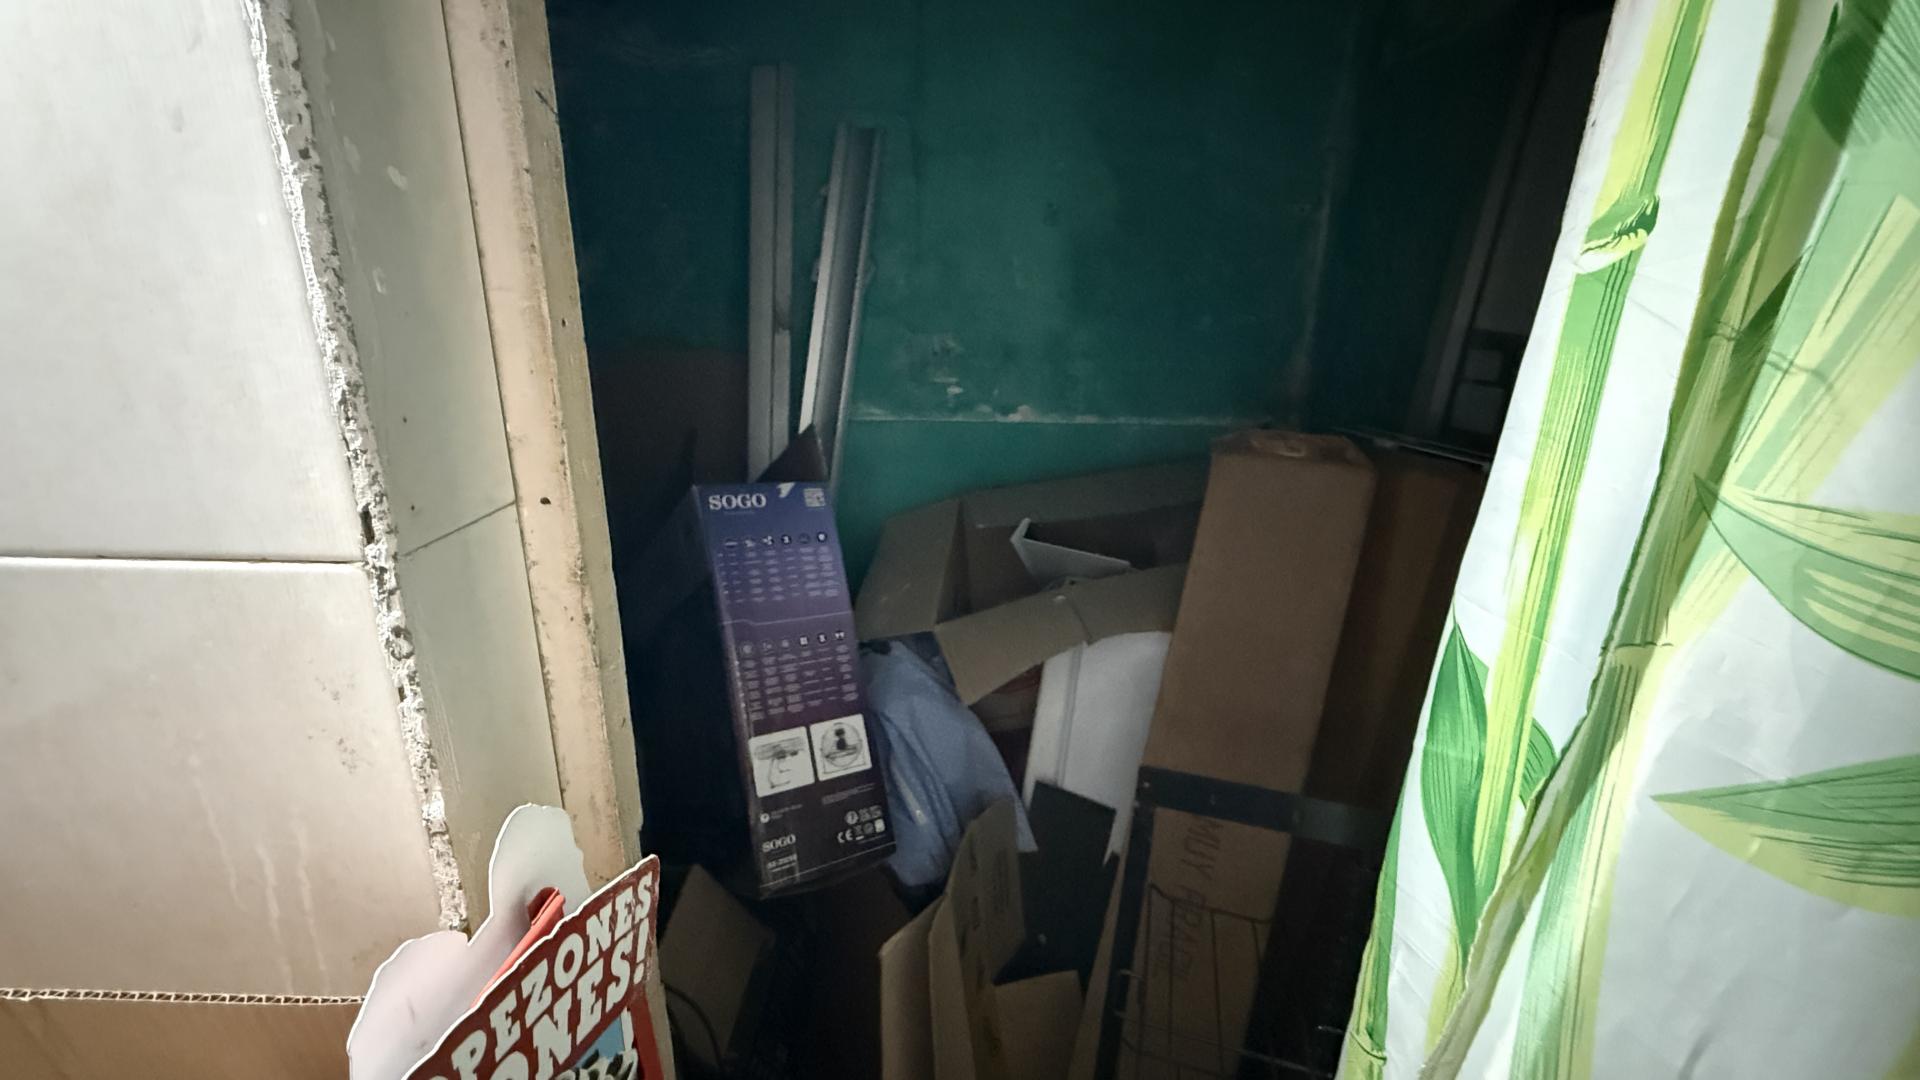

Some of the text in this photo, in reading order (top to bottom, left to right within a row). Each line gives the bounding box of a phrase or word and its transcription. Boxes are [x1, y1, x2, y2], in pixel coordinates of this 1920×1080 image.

[708, 493, 767, 511] SOGO
[762, 833, 796, 853] SOGO
[1179, 818, 1223, 880] MUY
[425, 871, 652, 1080] PEZONES
